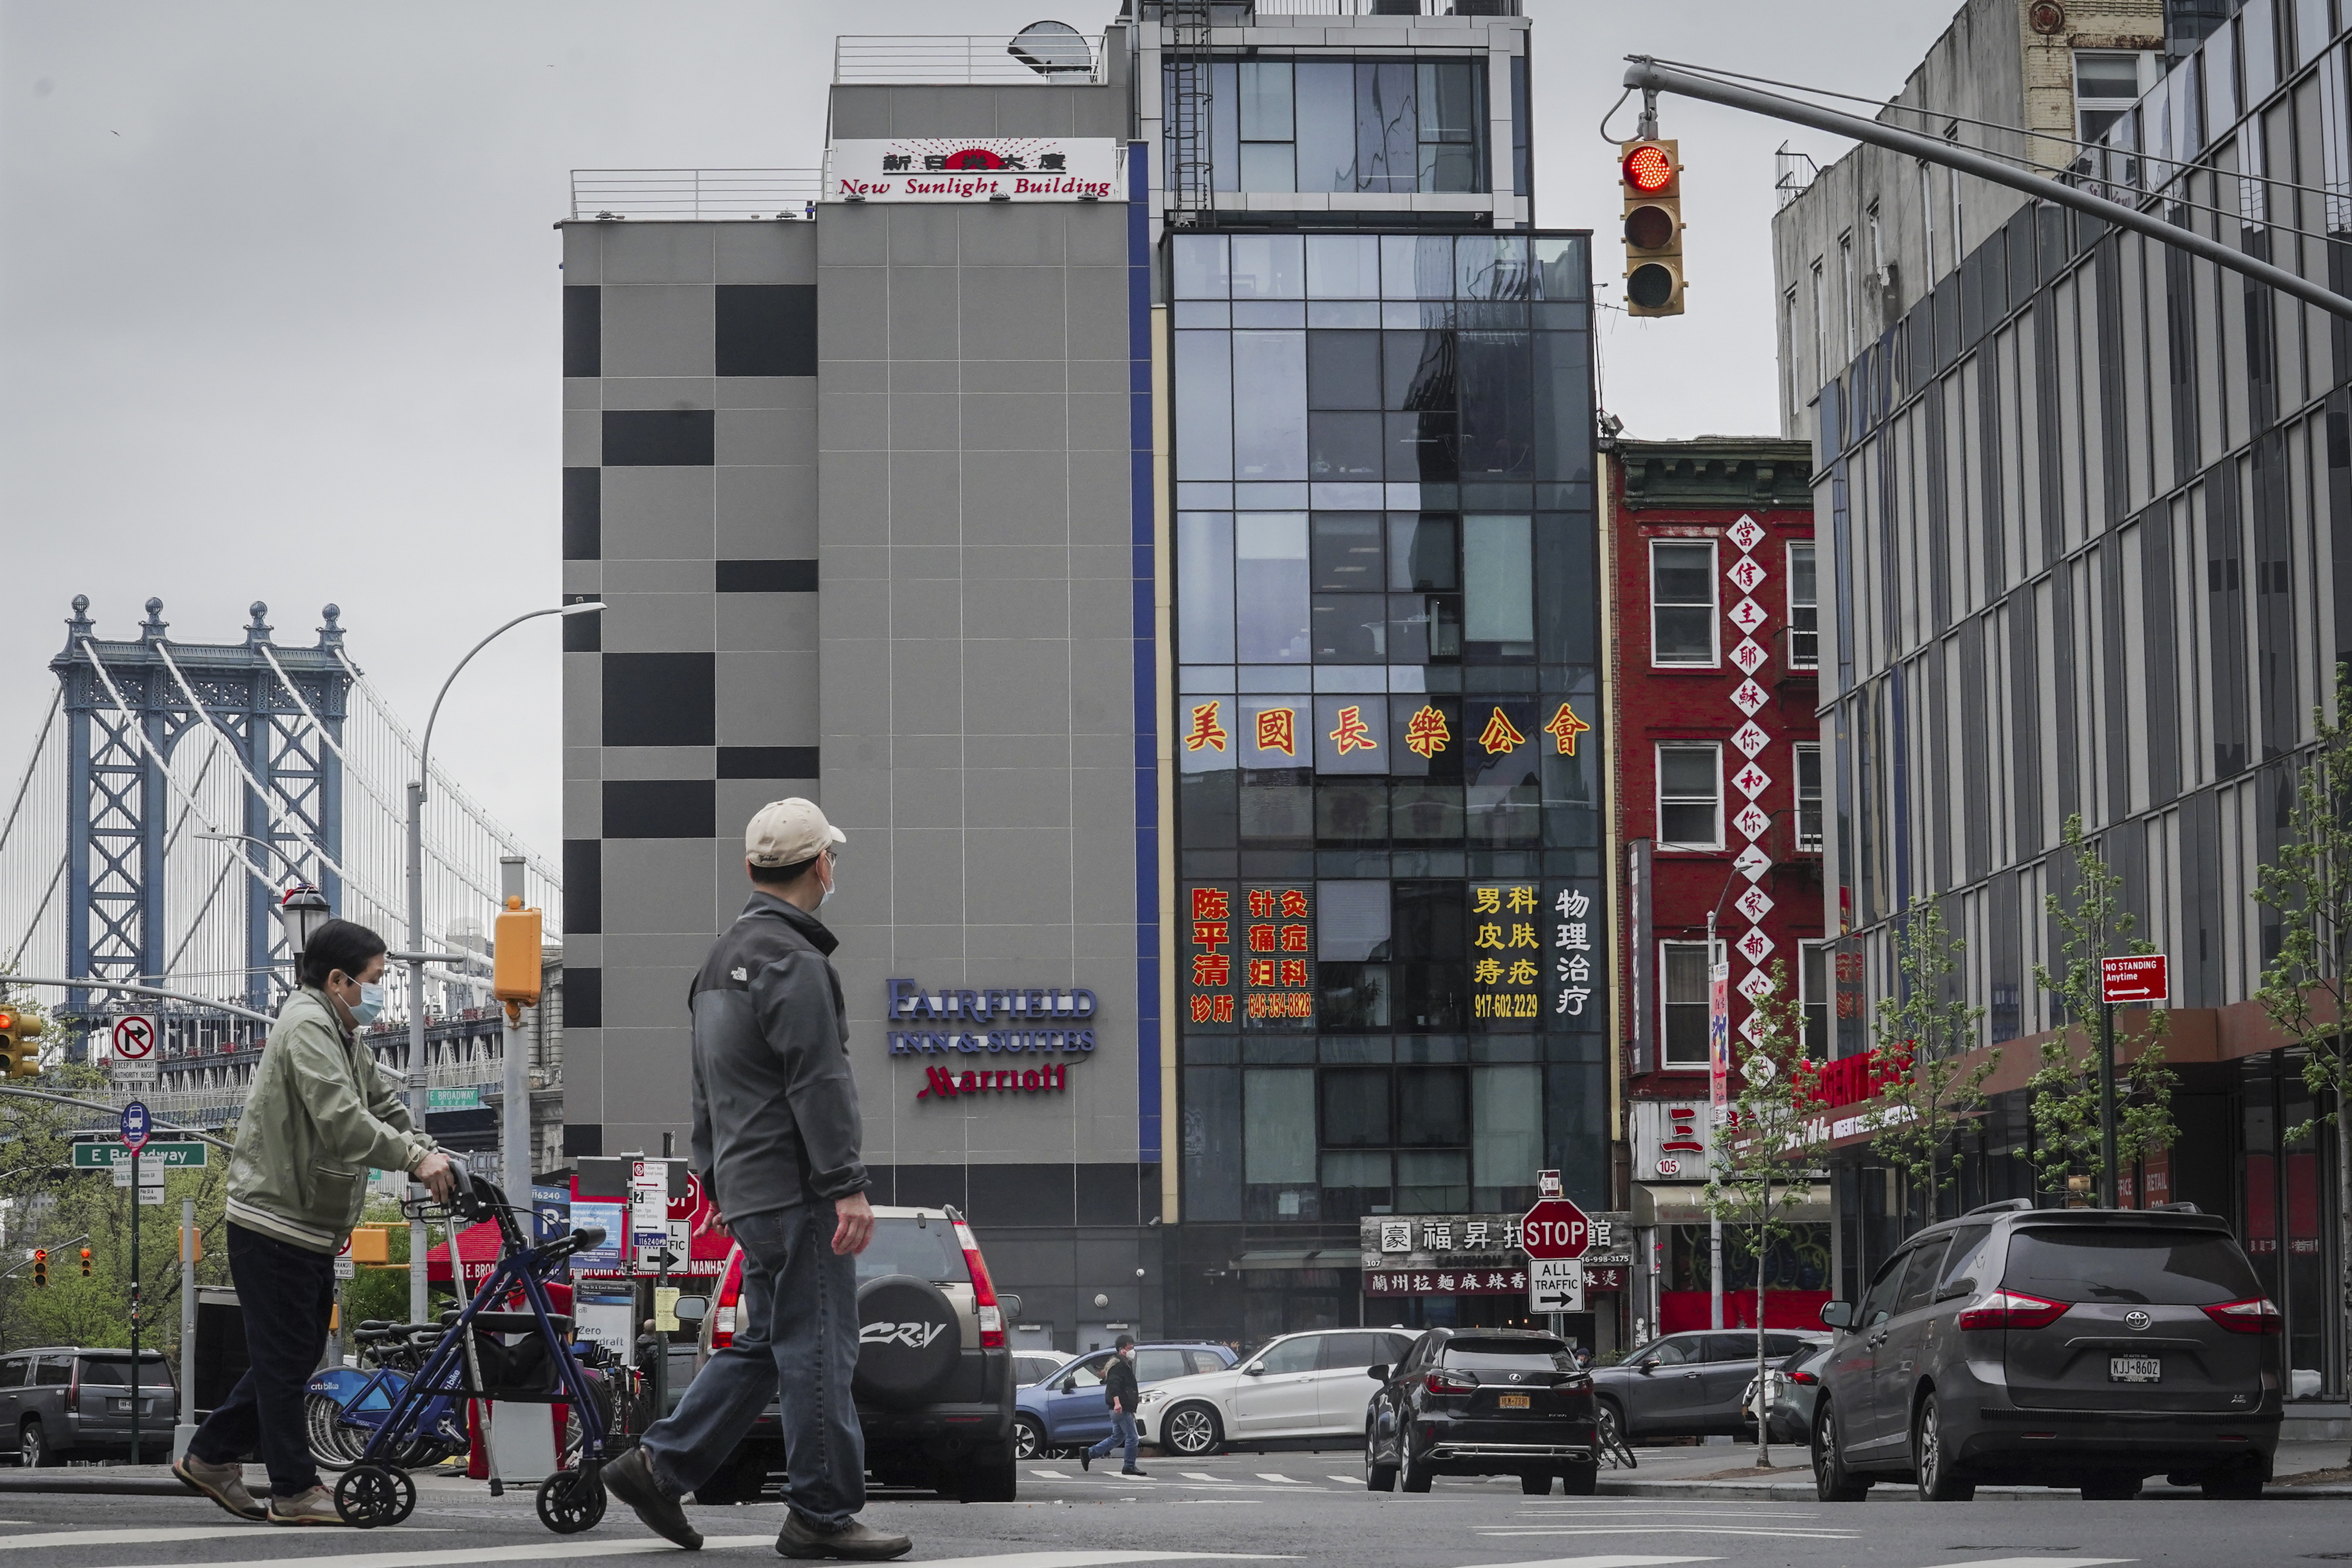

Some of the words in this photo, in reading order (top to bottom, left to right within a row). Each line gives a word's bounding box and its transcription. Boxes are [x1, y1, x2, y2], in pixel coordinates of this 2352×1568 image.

[840, 179, 891, 194] New
[906, 178, 998, 197] Sunlight
[1014, 178, 1111, 197] Building
[1185, 700, 1590, 759] 美國長樂公會
[1736, 521, 1768, 1075] 當信主耶穌你和你一家都必得
[1249, 890, 1308, 918] 针灸
[1473, 886, 1538, 915] 男科
[1192, 888, 1230, 987] 陈平清
[1249, 924, 1308, 953] 痛症
[1474, 922, 1539, 950] 皮肤
[1555, 889, 1591, 1017] 物理治疗
[1249, 959, 1308, 988] 妇科
[1474, 958, 1539, 986] 痔疮
[2119, 960, 2156, 971] STANDING
[2106, 973, 2138, 983] Anytime
[886, 978, 1098, 1023] FAIRFIELD
[1190, 994, 1234, 1023] 诊所
[1248, 993, 1311, 1019] 646-354-8828
[1475, 994, 1538, 1018] 917-602-2229
[887, 1030, 951, 1054] INN
[956, 1031, 982, 1053] &
[987, 1029, 1095, 1053] SUITES
[916, 1063, 1066, 1099] Marriott
[430, 1091, 434, 1100] E
[438, 1091, 475, 1100] BROADWAY
[92, 1149, 102, 1161] E
[1660, 1161, 1676, 1172] 105
[2118, 1178, 2132, 1196] FICE
[2147, 1172, 2167, 1192] RETAIL
[636, 1192, 642, 1202] 2
[1381, 1219, 1611, 1251] 豪福昇拉館
[1526, 1221, 1584, 1246] STOP
[466, 1264, 473, 1278] E.
[1372, 1269, 1619, 1292] 蘭州拉麵麻辣香辣燙
[1542, 1263, 1571, 1276] ALL
[1535, 1279, 1578, 1290] TRAFFIC
[579, 1326, 601, 1335] Zero
[446, 1369, 460, 1386] bike
[2114, 1360, 2130, 1374] KJJ
[2136, 1361, 2158, 1374] 8602
[323, 1382, 339, 1390] bike
